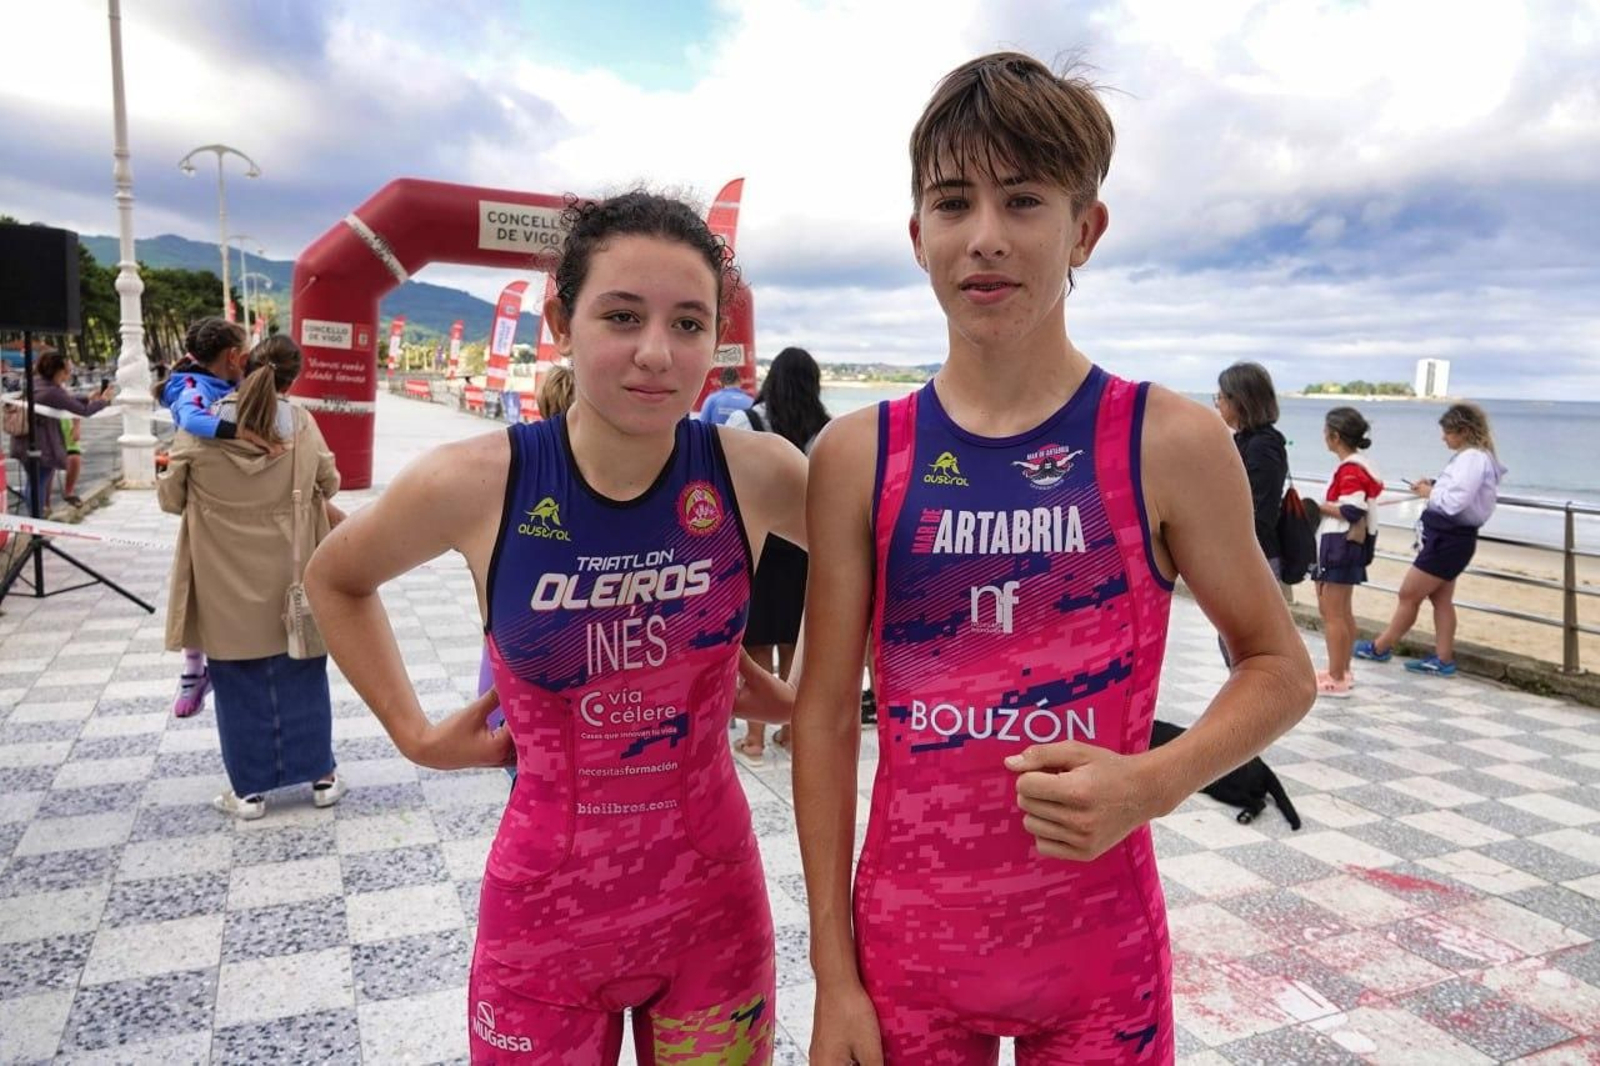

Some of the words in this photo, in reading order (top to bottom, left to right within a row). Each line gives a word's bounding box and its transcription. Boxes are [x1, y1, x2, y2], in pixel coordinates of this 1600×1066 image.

[487, 211, 569, 230] CONCELL
[497, 228, 518, 242] DE
[523, 230, 560, 246] VIGO
[308, 333, 319, 341] DE
[322, 335, 343, 343] VIGO
[924, 474, 970, 487] austral
[518, 523, 572, 542] austral
[932, 505, 1086, 554] ARTABRIA
[577, 548, 675, 572] TRIATLON
[531, 558, 713, 611] OLEIROS
[586, 605, 667, 676] INÉS
[608, 688, 642, 705] vía
[610, 706, 677, 724] célere
[911, 697, 1096, 743] BOUZÓN
[577, 799, 678, 815] biolibros.com
